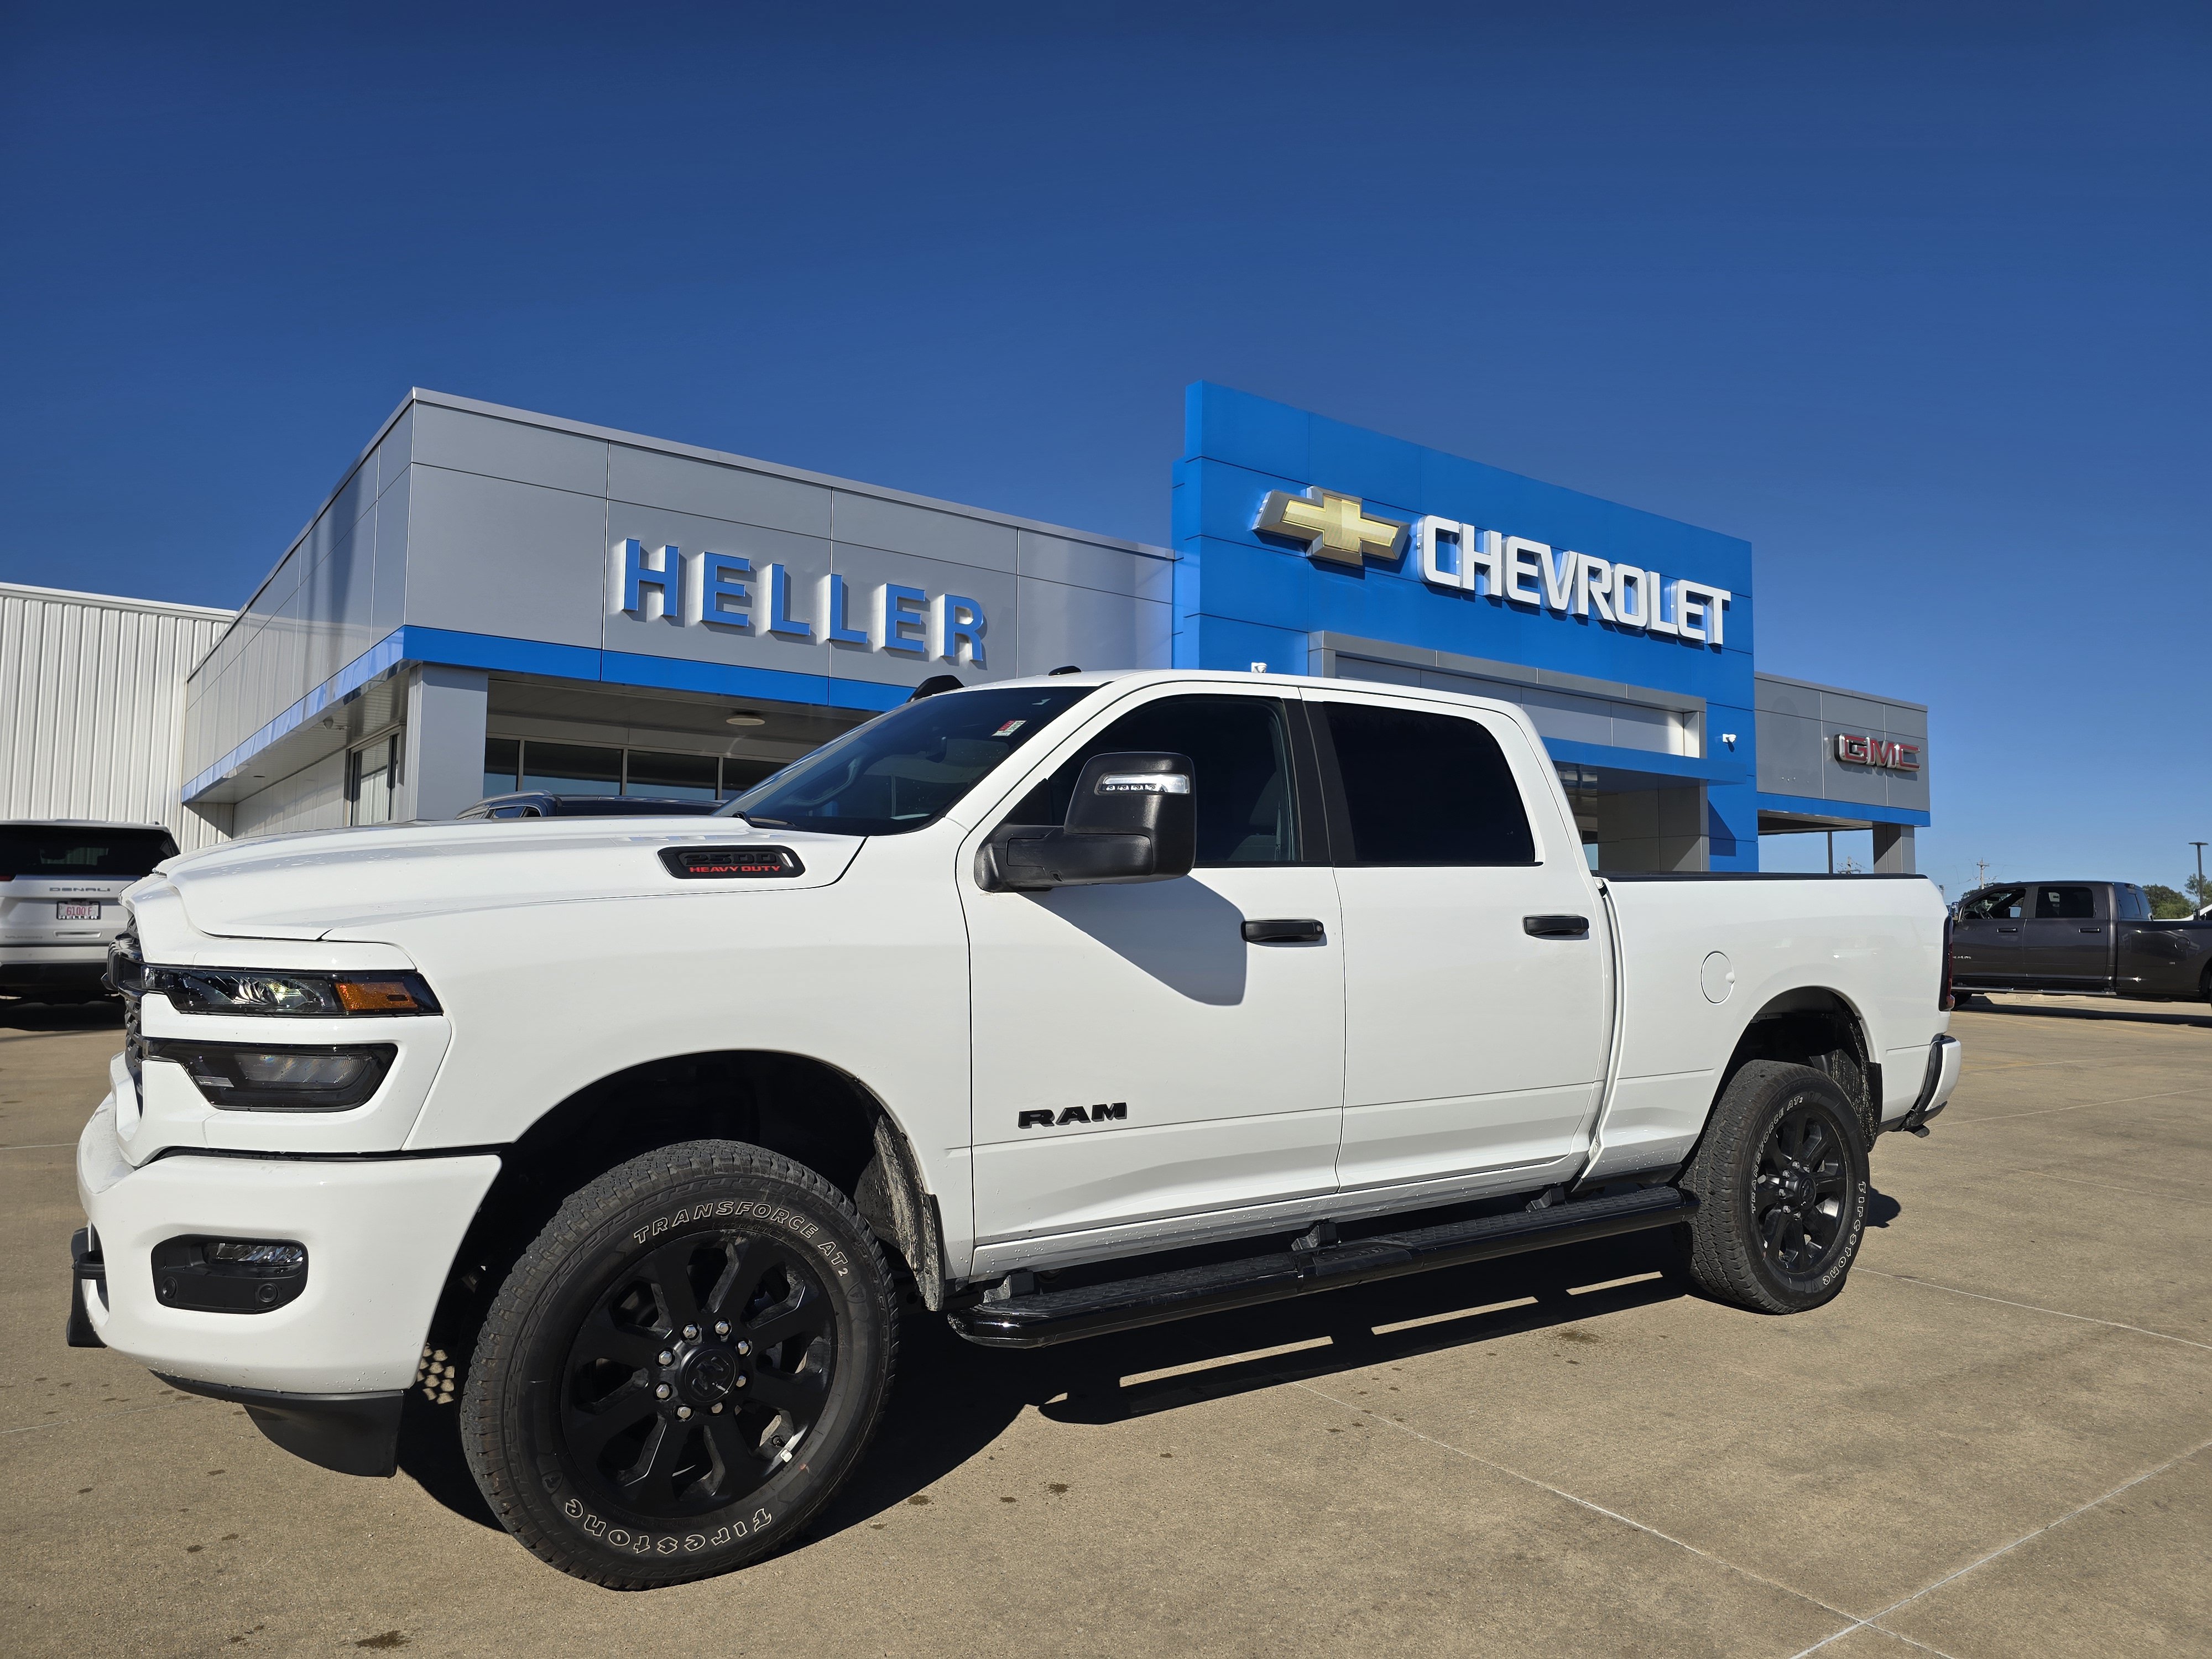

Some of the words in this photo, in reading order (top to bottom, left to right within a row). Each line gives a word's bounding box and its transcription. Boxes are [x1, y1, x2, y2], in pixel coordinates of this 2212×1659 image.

[622, 538, 983, 661] HELLER
[1417, 514, 1731, 645] CHEVROLET
[1834, 733, 1921, 772] GMC
[684, 853, 777, 865] 2500
[66, 907, 86, 916] 6100
[88, 907, 93, 915] F
[1018, 1102, 1128, 1129] RAM
[633, 1201, 819, 1245] TRANSFORCE
[1822, 1181, 1866, 1286] Firestone
[564, 1498, 773, 1555] Firestone
